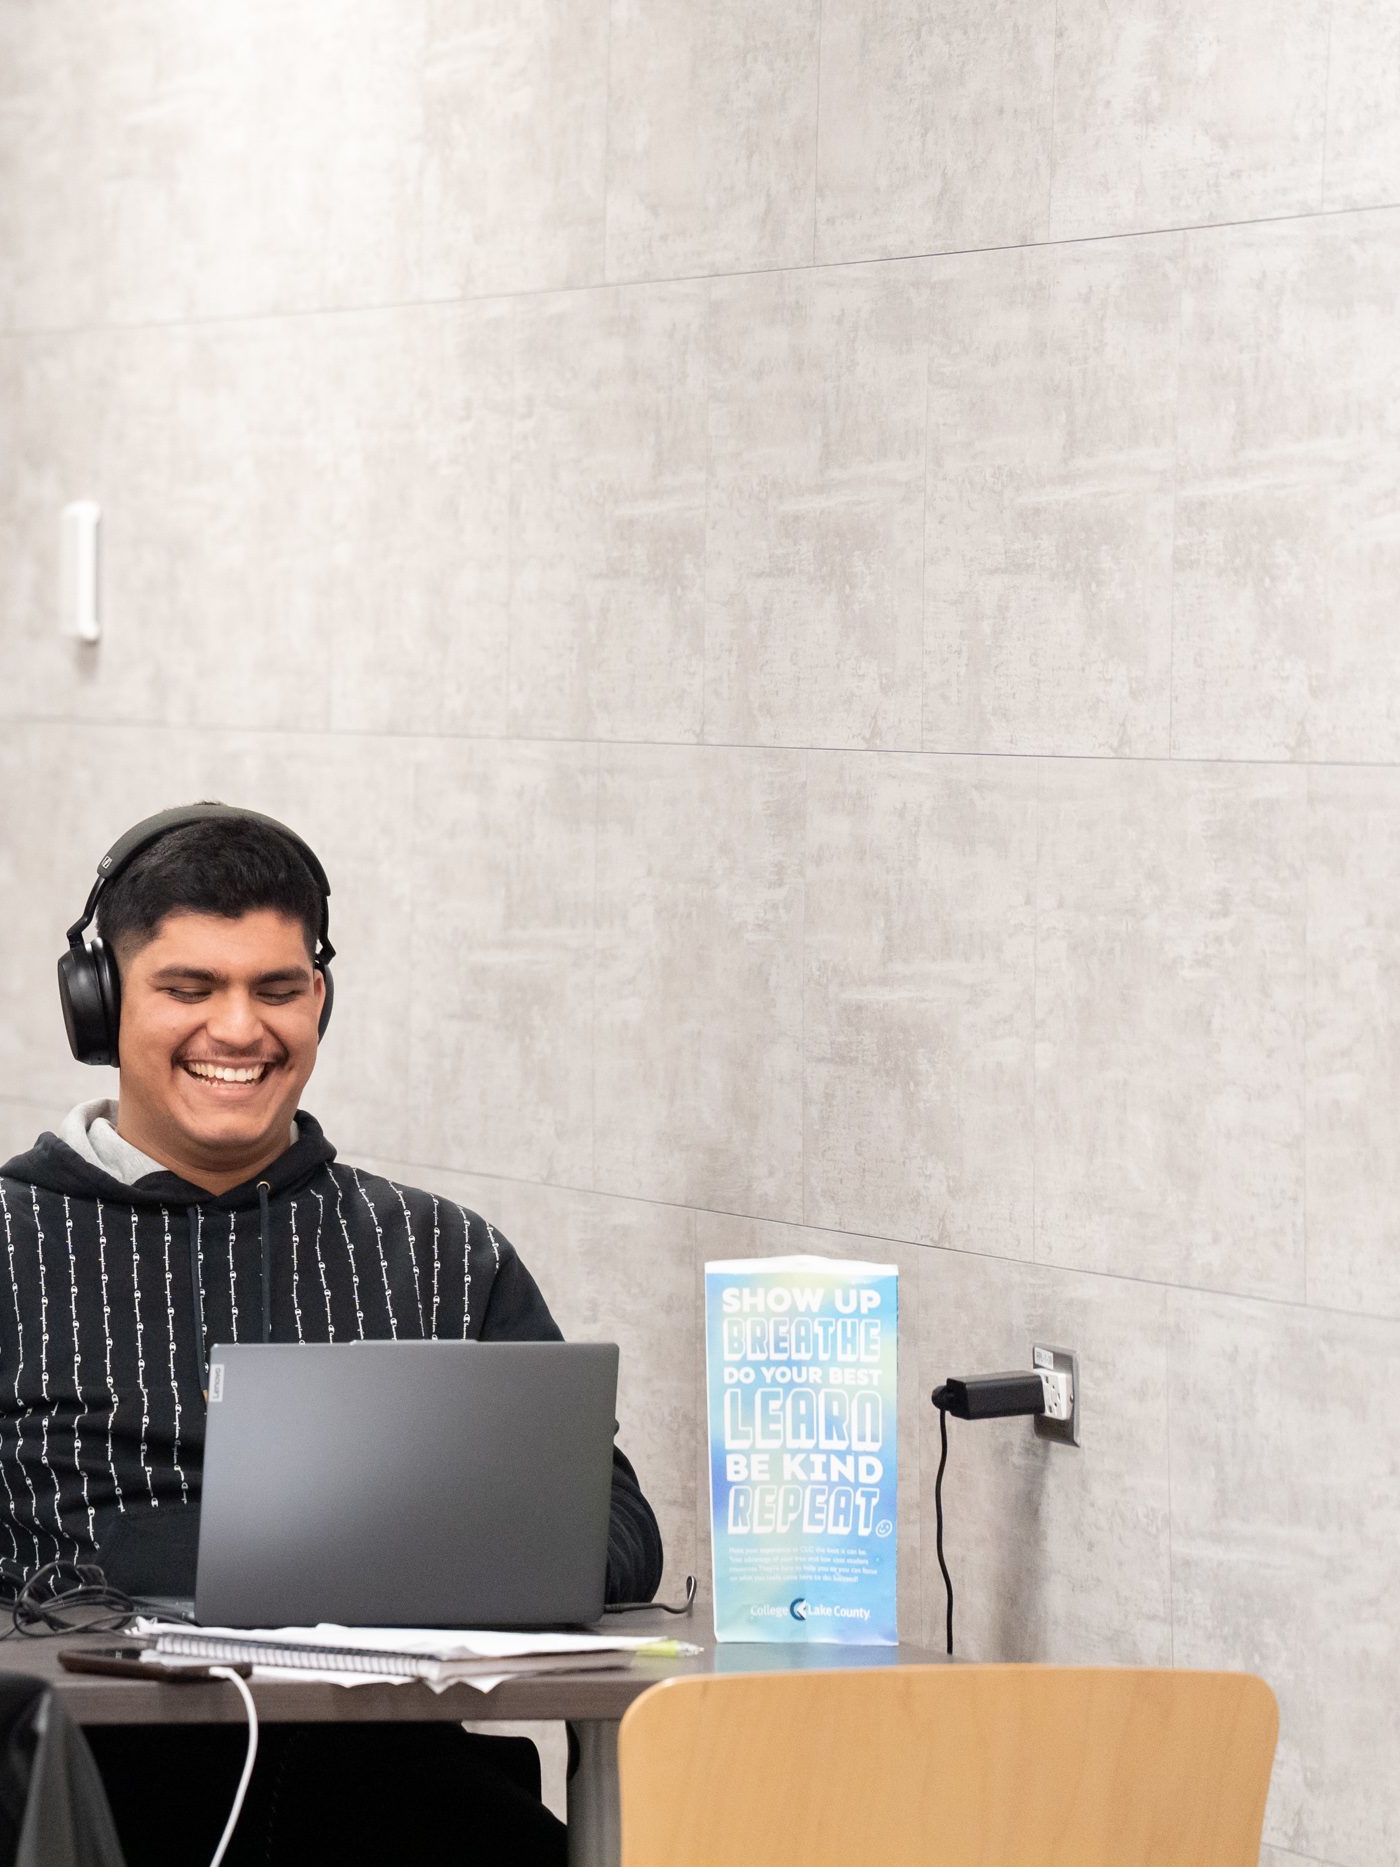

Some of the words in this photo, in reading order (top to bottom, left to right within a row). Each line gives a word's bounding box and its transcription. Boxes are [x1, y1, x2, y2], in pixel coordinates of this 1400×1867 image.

[722, 1287, 825, 1314] SHOW
[834, 1288, 882, 1314] UP
[723, 1317, 882, 1363] BREATHE
[723, 1366, 756, 1385] DO
[760, 1366, 823, 1385] YOUR
[829, 1367, 883, 1386] BEST
[723, 1387, 883, 1453] LEARN
[725, 1453, 770, 1482] BE
[782, 1454, 884, 1485] KIND
[727, 1485, 880, 1537] REPEAT
[750, 1604, 789, 1618] College
[807, 1604, 832, 1617] Lake
[834, 1605, 871, 1621] County
